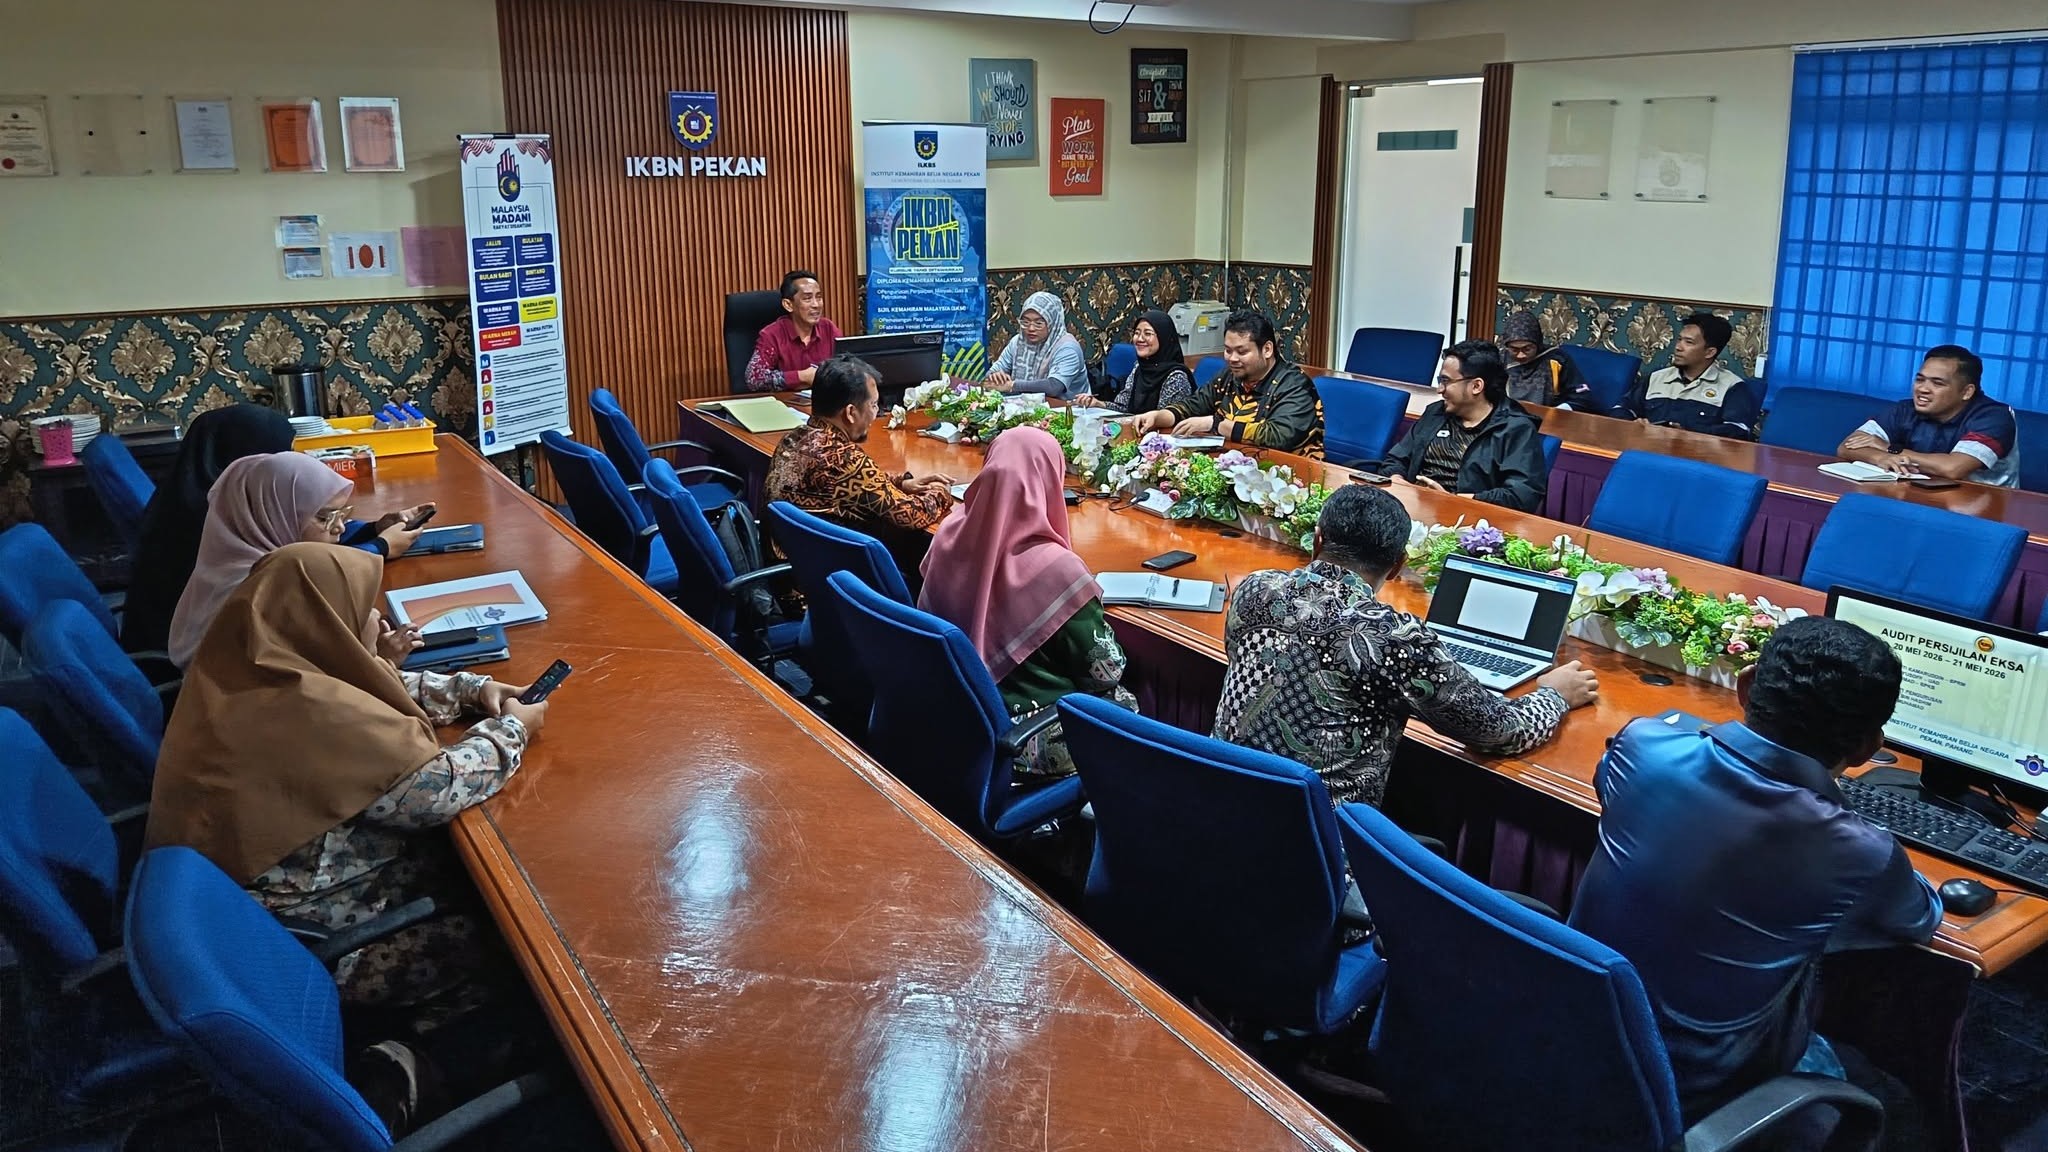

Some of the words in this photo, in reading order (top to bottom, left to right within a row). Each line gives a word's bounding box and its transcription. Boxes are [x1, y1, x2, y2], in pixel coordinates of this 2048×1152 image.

[985, 73, 989, 86] I
[991, 70, 1014, 87] THINK
[977, 88, 992, 105] WE
[994, 84, 1028, 108] SHOULD
[1139, 89, 1151, 102] SIT
[1154, 81, 1167, 110] &
[995, 120, 1017, 134] STOP
[1063, 116, 1094, 138] Plan
[987, 131, 1025, 147] RYING
[1062, 141, 1094, 154] WORK
[626, 156, 684, 177] IKBN
[690, 156, 766, 177] PEKAN
[1064, 166, 1090, 186] Goal
[491, 205, 530, 213] MALAYSIA
[492, 213, 531, 224] MADANI
[903, 197, 951, 228] IKBN
[896, 228, 960, 260] PEKAN
[482, 360, 488, 368] M
[1881, 628, 1915, 643] AUDIT
[1918, 638, 1987, 663] PERSIJILAN
[1990, 657, 2024, 673] EKSA
[1893, 642, 1903, 650] 20
[1905, 646, 1920, 655] MEI
[1923, 651, 1943, 662] 2026
[1953, 659, 1962, 667] 21
[1965, 663, 1982, 672] MEI
[1985, 668, 2006, 679] 2026
[1906, 690, 1942, 704] PENGURUSAN
[1919, 727, 1957, 743] KEMAHIRAN
[1959, 740, 1978, 750] BELIA
[1980, 746, 2009, 759] NEGARA
[1945, 742, 1973, 755] PAHANG
